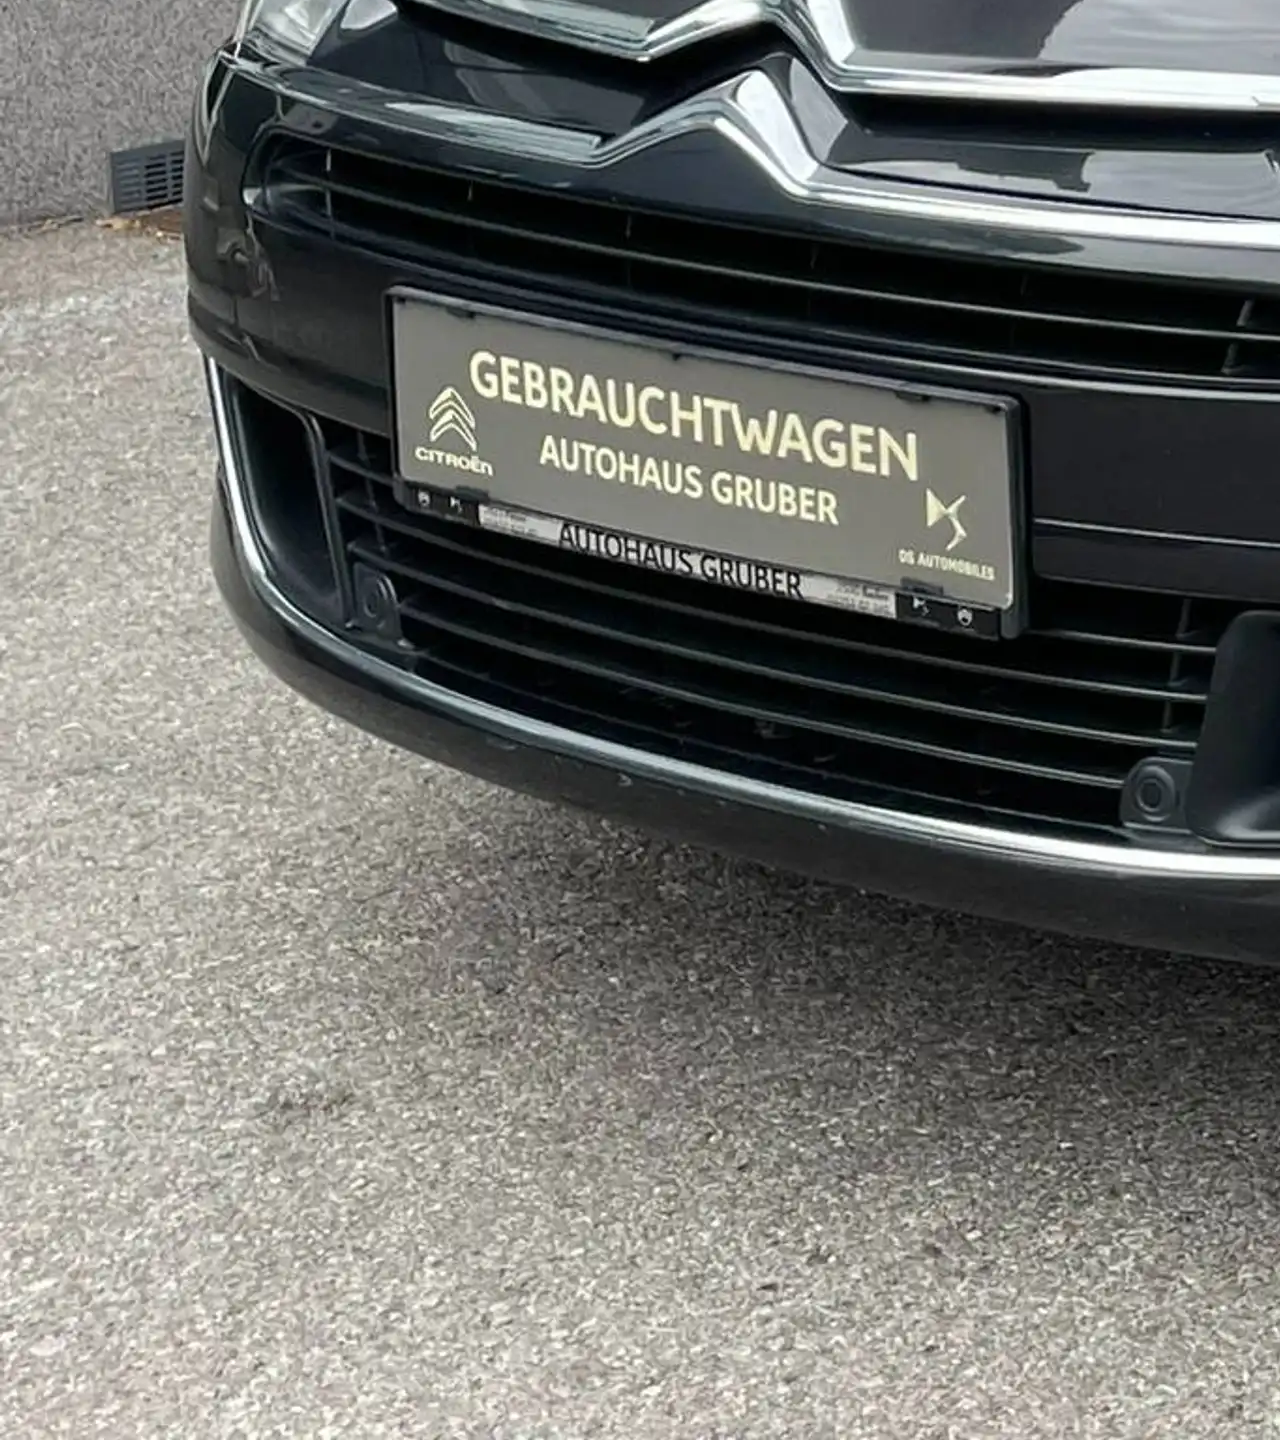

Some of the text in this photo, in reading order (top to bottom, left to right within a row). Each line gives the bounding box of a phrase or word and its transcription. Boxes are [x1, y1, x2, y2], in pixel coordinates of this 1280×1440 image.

[469, 351, 919, 481] GEBRAUCHTWAGEN
[539, 434, 840, 526] AUTOHAUS GRUBER
[558, 522, 694, 576] AUTOHAUS
[700, 553, 804, 600] GRUBER
